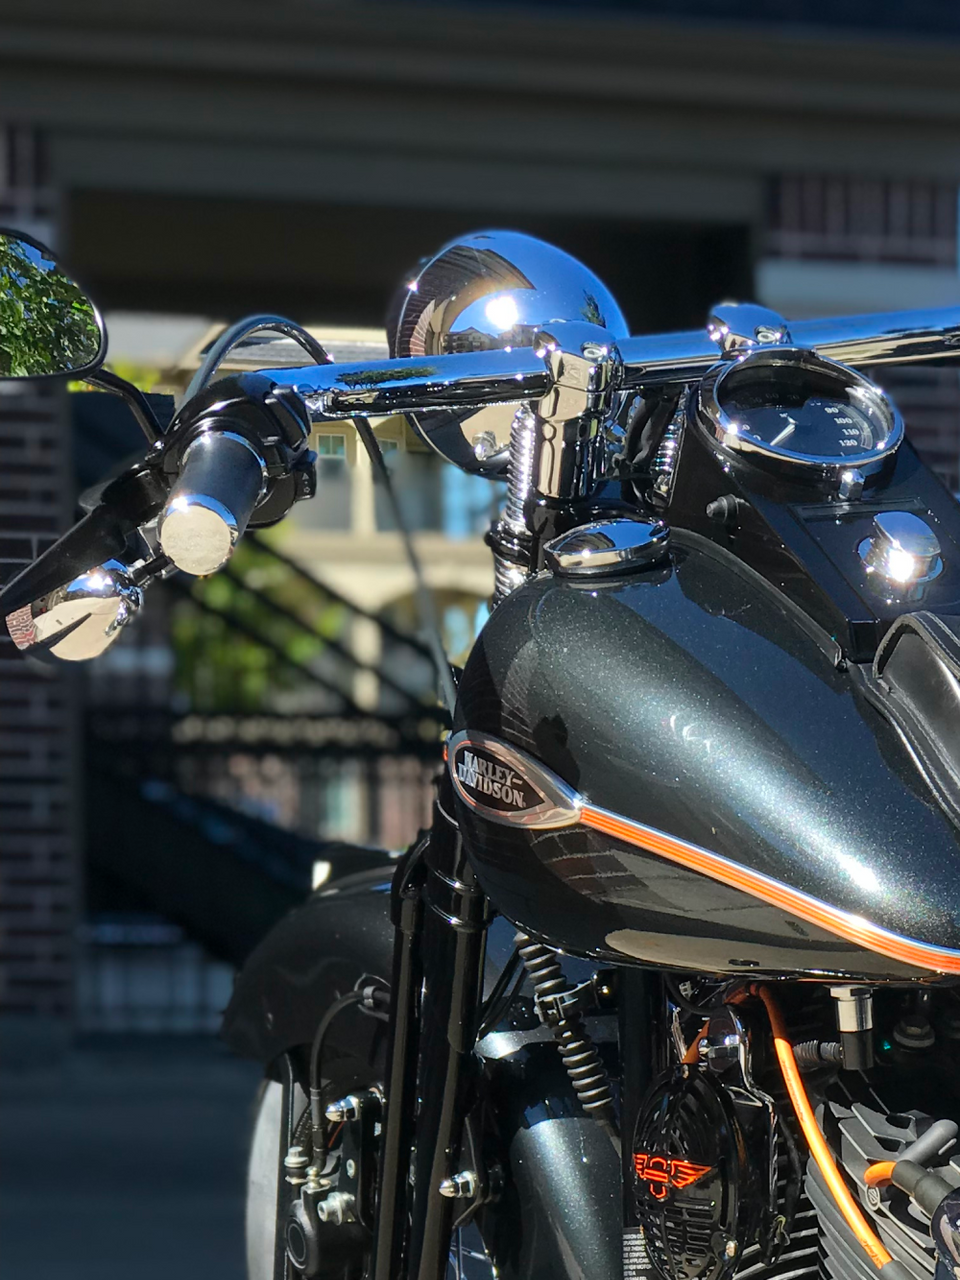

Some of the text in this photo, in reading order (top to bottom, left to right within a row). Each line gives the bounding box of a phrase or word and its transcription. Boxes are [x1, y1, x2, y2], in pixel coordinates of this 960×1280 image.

[834, 416, 853, 424] 100
[842, 428, 860, 436] 110
[839, 439, 858, 447] 120
[457, 762, 525, 808] DAVIDSON
